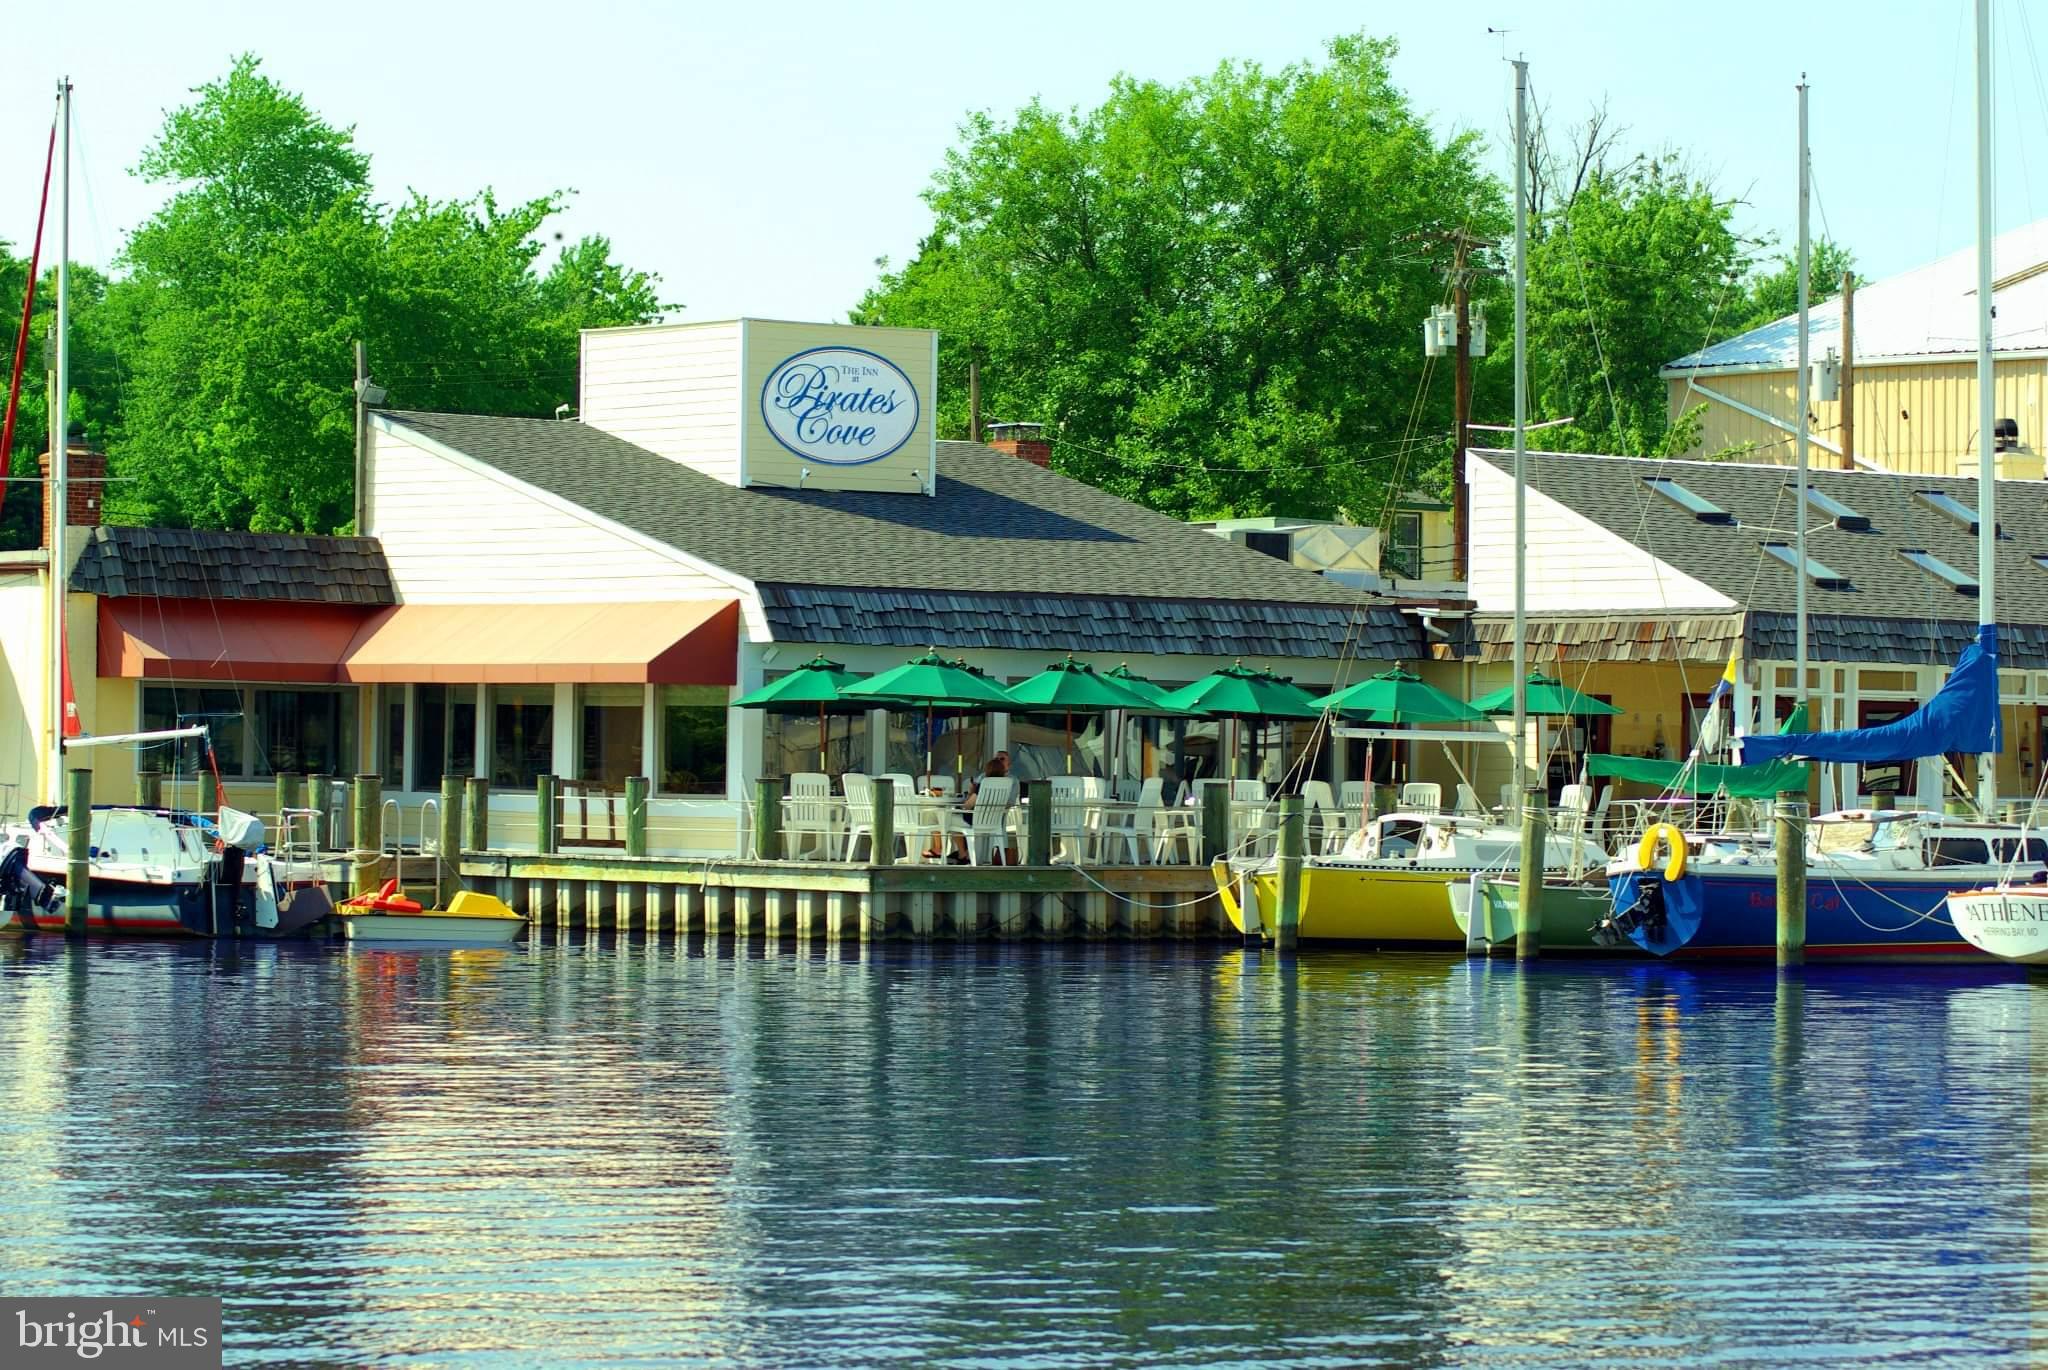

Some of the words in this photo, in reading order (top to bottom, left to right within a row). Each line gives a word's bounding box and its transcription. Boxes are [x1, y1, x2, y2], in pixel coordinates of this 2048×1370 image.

[775, 363, 907, 419] Pirates
[840, 365, 860, 376] THE
[862, 366, 879, 377] INN
[796, 403, 877, 446] Cove
